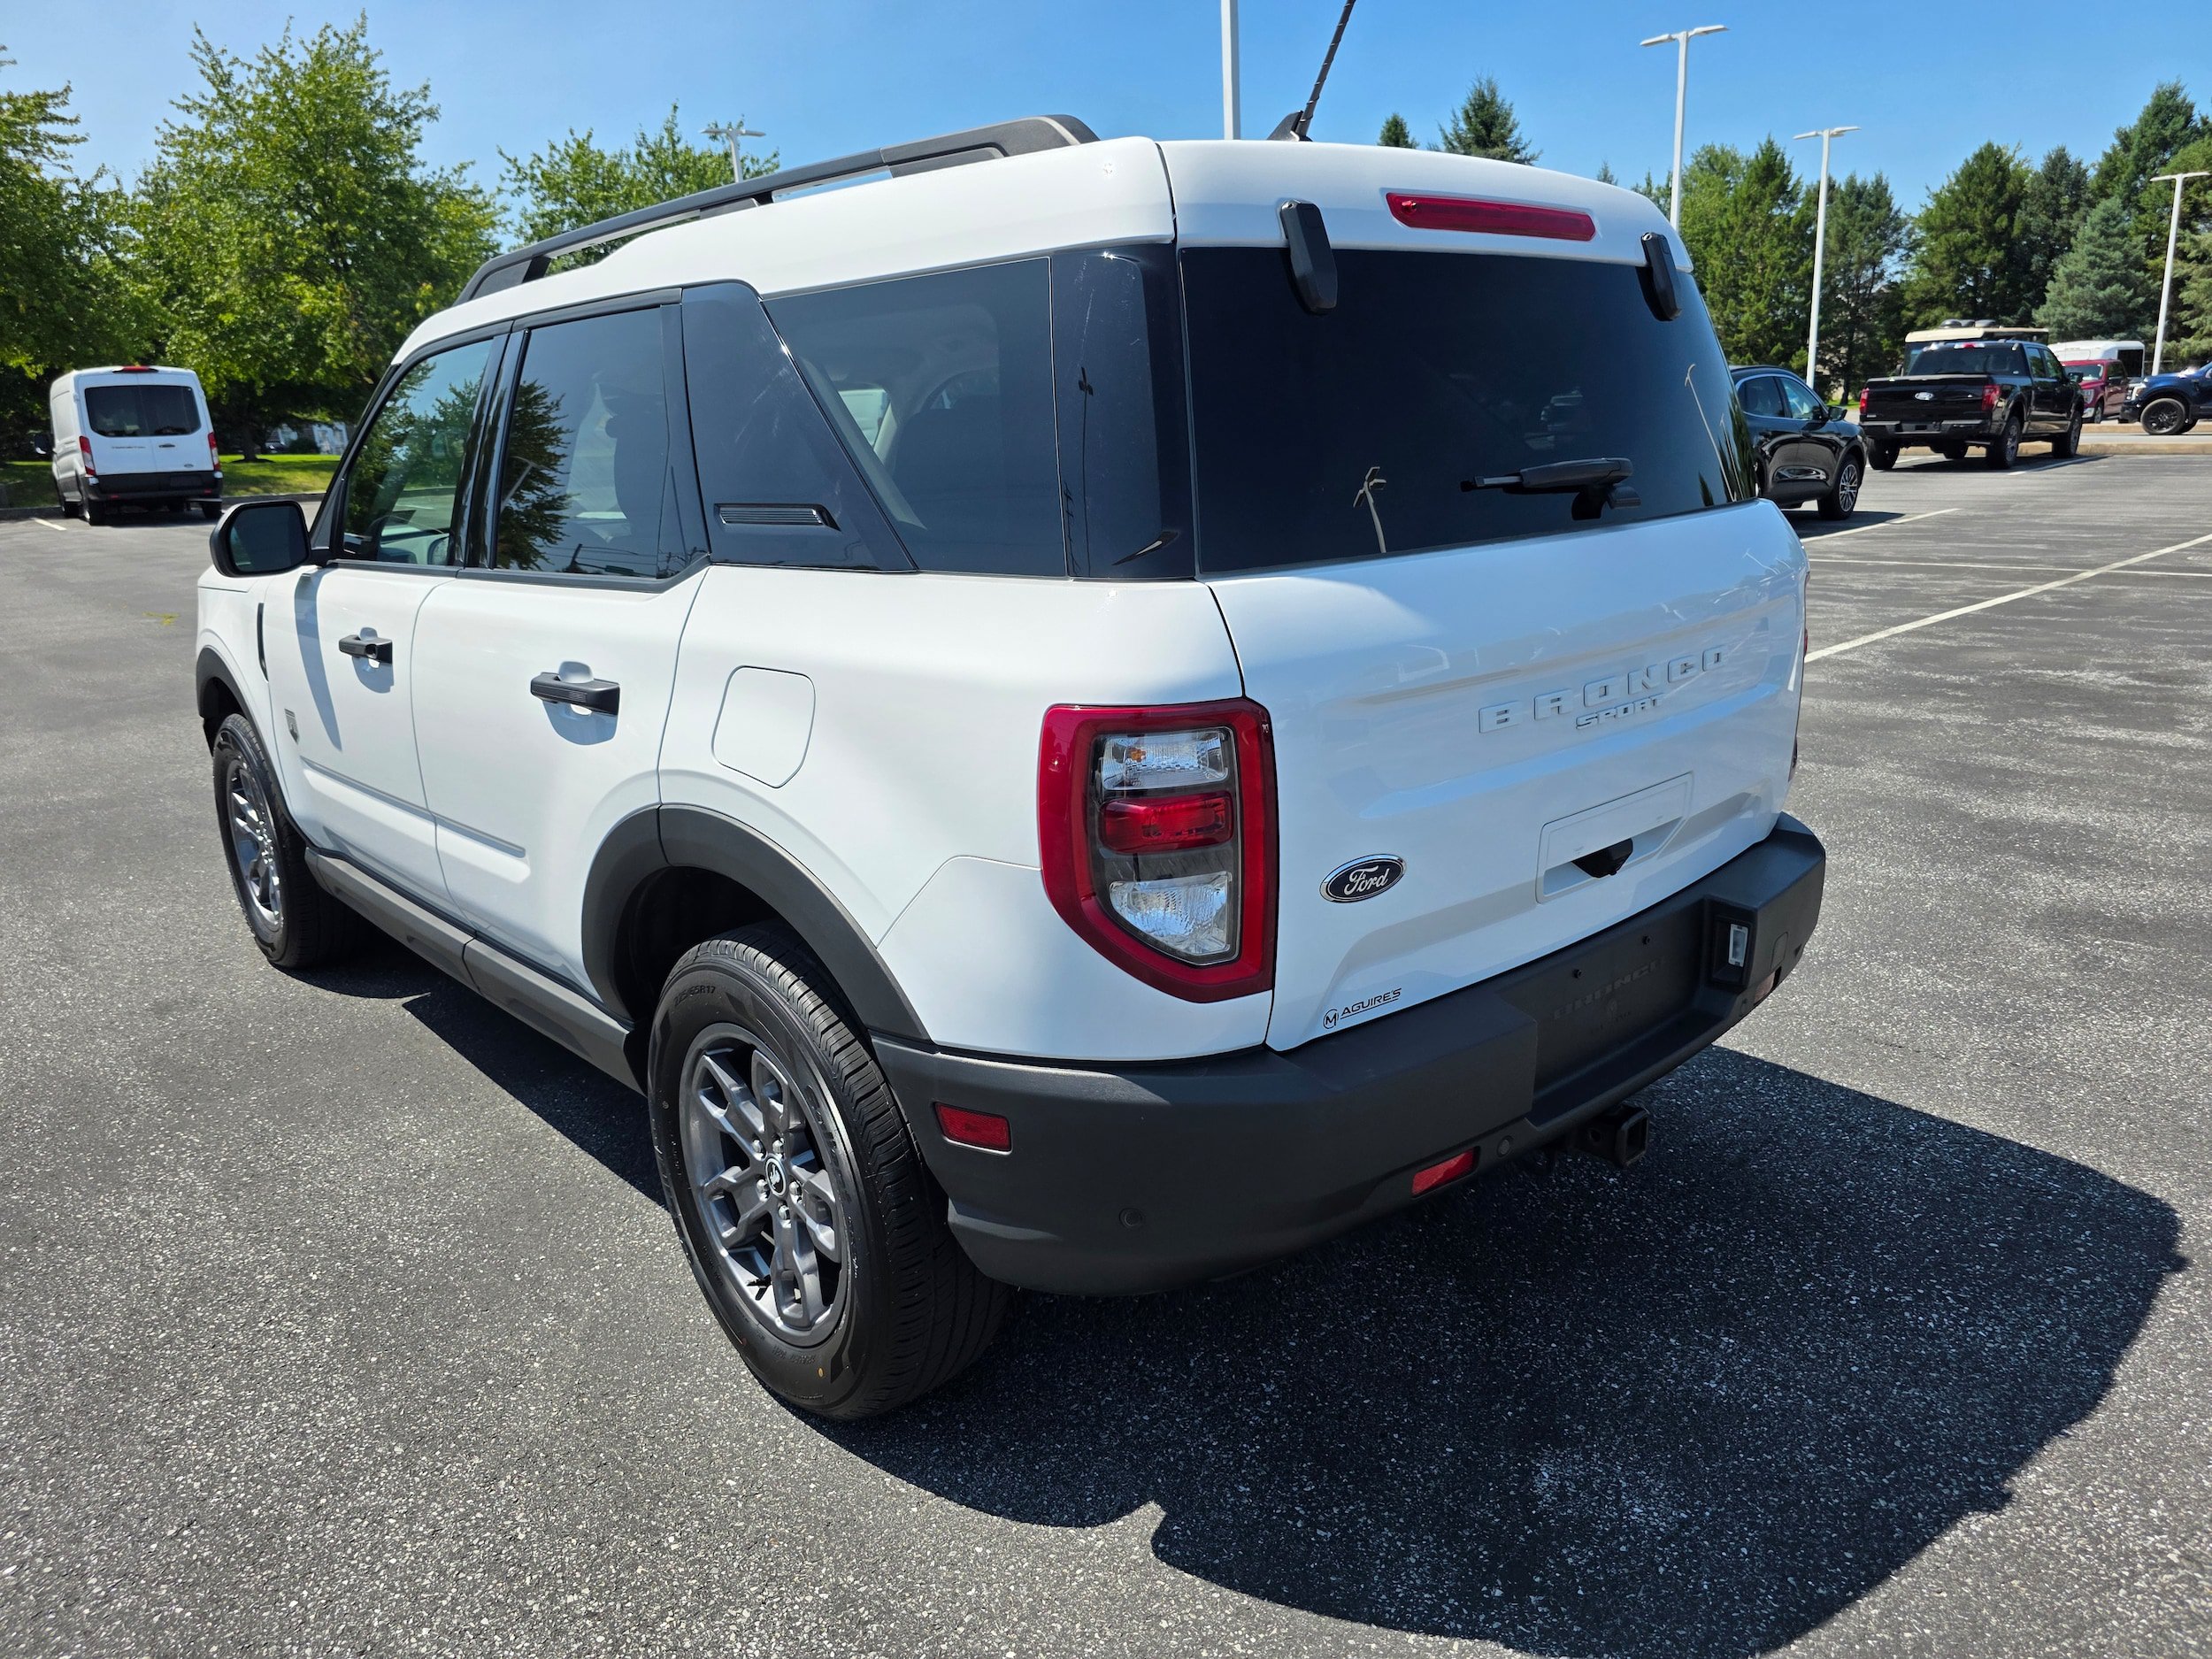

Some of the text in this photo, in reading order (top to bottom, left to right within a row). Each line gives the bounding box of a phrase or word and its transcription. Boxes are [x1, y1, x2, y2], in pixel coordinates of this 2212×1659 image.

[1479, 644, 1726, 733] BRONCO
[1576, 693, 1665, 730] SPORT
[1343, 864, 1391, 896] Ford
